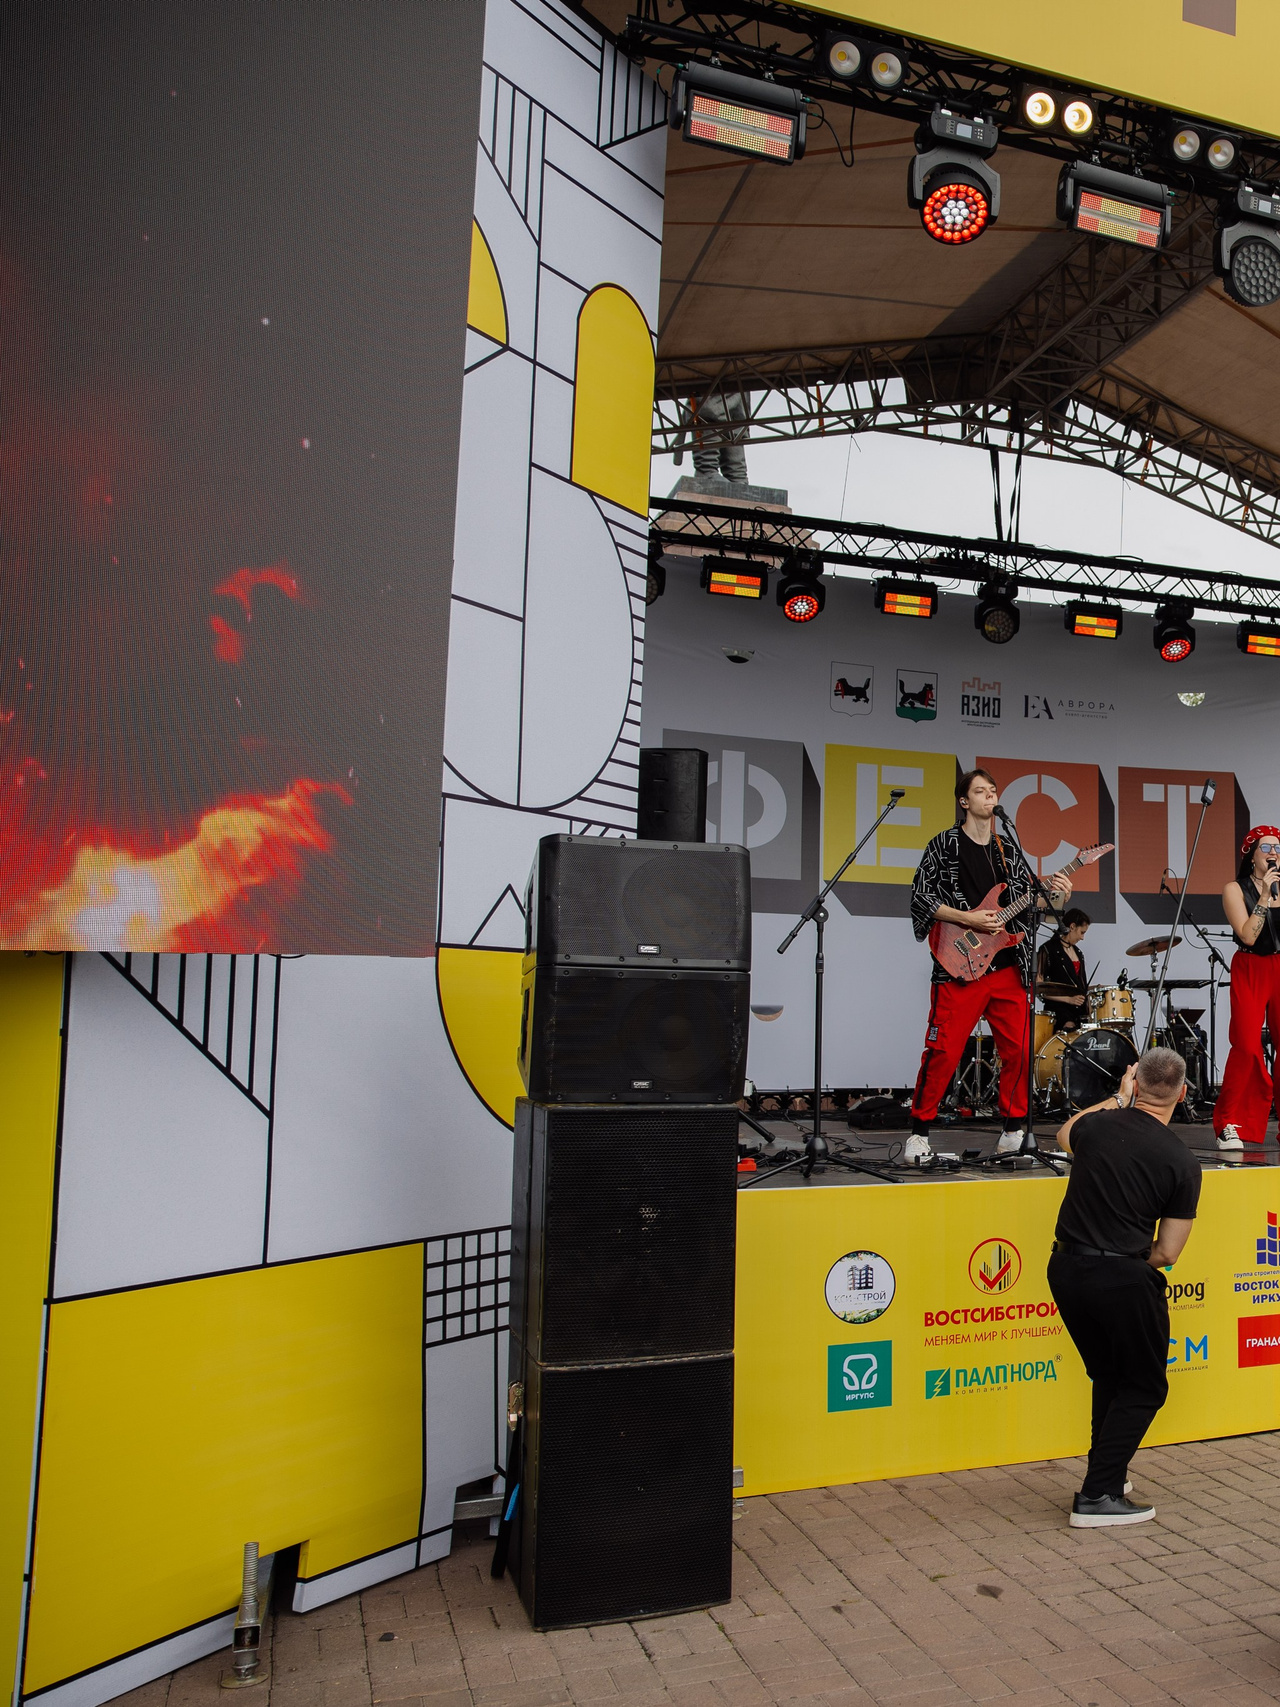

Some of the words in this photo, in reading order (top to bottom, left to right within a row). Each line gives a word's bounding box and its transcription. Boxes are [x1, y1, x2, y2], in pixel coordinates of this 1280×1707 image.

[1058, 699, 1115, 711] АВРОРА
[1084, 1037, 1111, 1051] Pearl
[1234, 1271, 1253, 1279] группа
[1234, 1279, 1280, 1292] ВОСТОК
[1165, 1282, 1205, 1304] ород
[1173, 1303, 1205, 1312] КОМПАНИЯ
[924, 1333, 971, 1347] МЕНЯЕМ
[974, 1330, 998, 1342] МИР
[1001, 1329, 1008, 1341] К
[1010, 1325, 1064, 1340] ЛУЧШЕМУ
[846, 1391, 875, 1401] ИРГУПС
[955, 1385, 1009, 1396] компания
